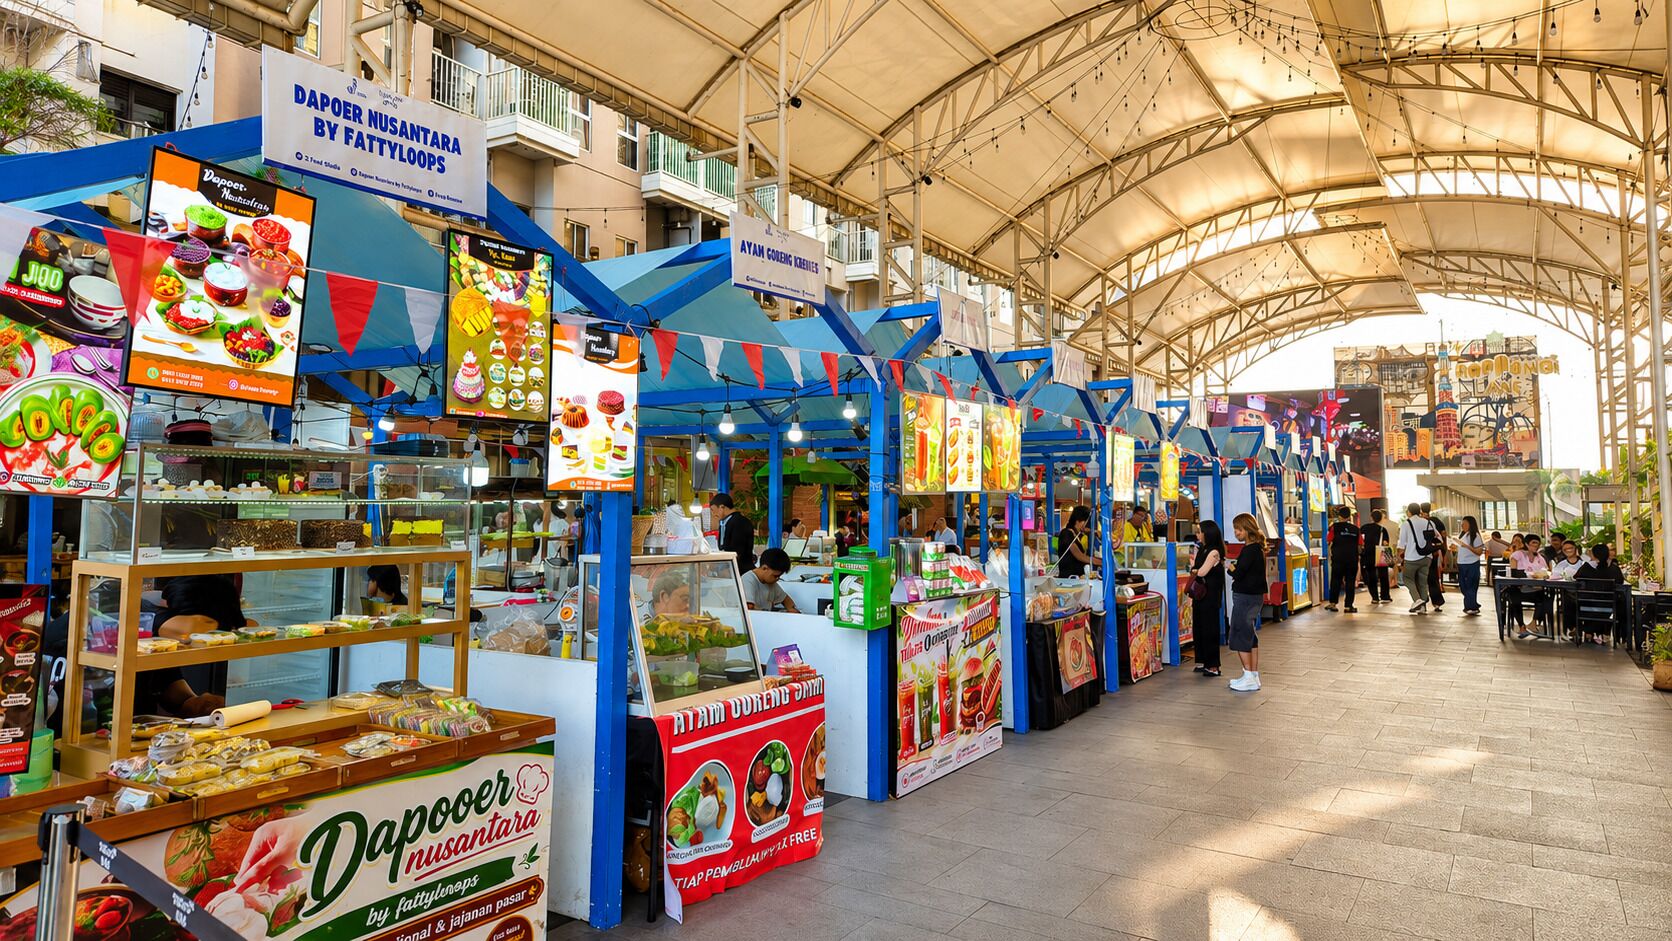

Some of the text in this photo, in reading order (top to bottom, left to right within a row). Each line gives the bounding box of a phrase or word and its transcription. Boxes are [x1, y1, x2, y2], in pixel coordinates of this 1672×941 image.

[294, 84, 363, 124] DAPOER
[368, 108, 462, 155] NUSANTARA
[313, 116, 446, 174] BY FATTYLOOPS
[299, 769, 516, 919] Dapooer
[404, 809, 540, 875] nusantara
[674, 872, 704, 889] TIAP
[790, 828, 817, 847] FREE
[366, 907, 391, 927] by
[397, 923, 432, 941] ional
[435, 919, 446, 934] &
[448, 902, 493, 933] jajanan
[496, 889, 528, 913] pasar
